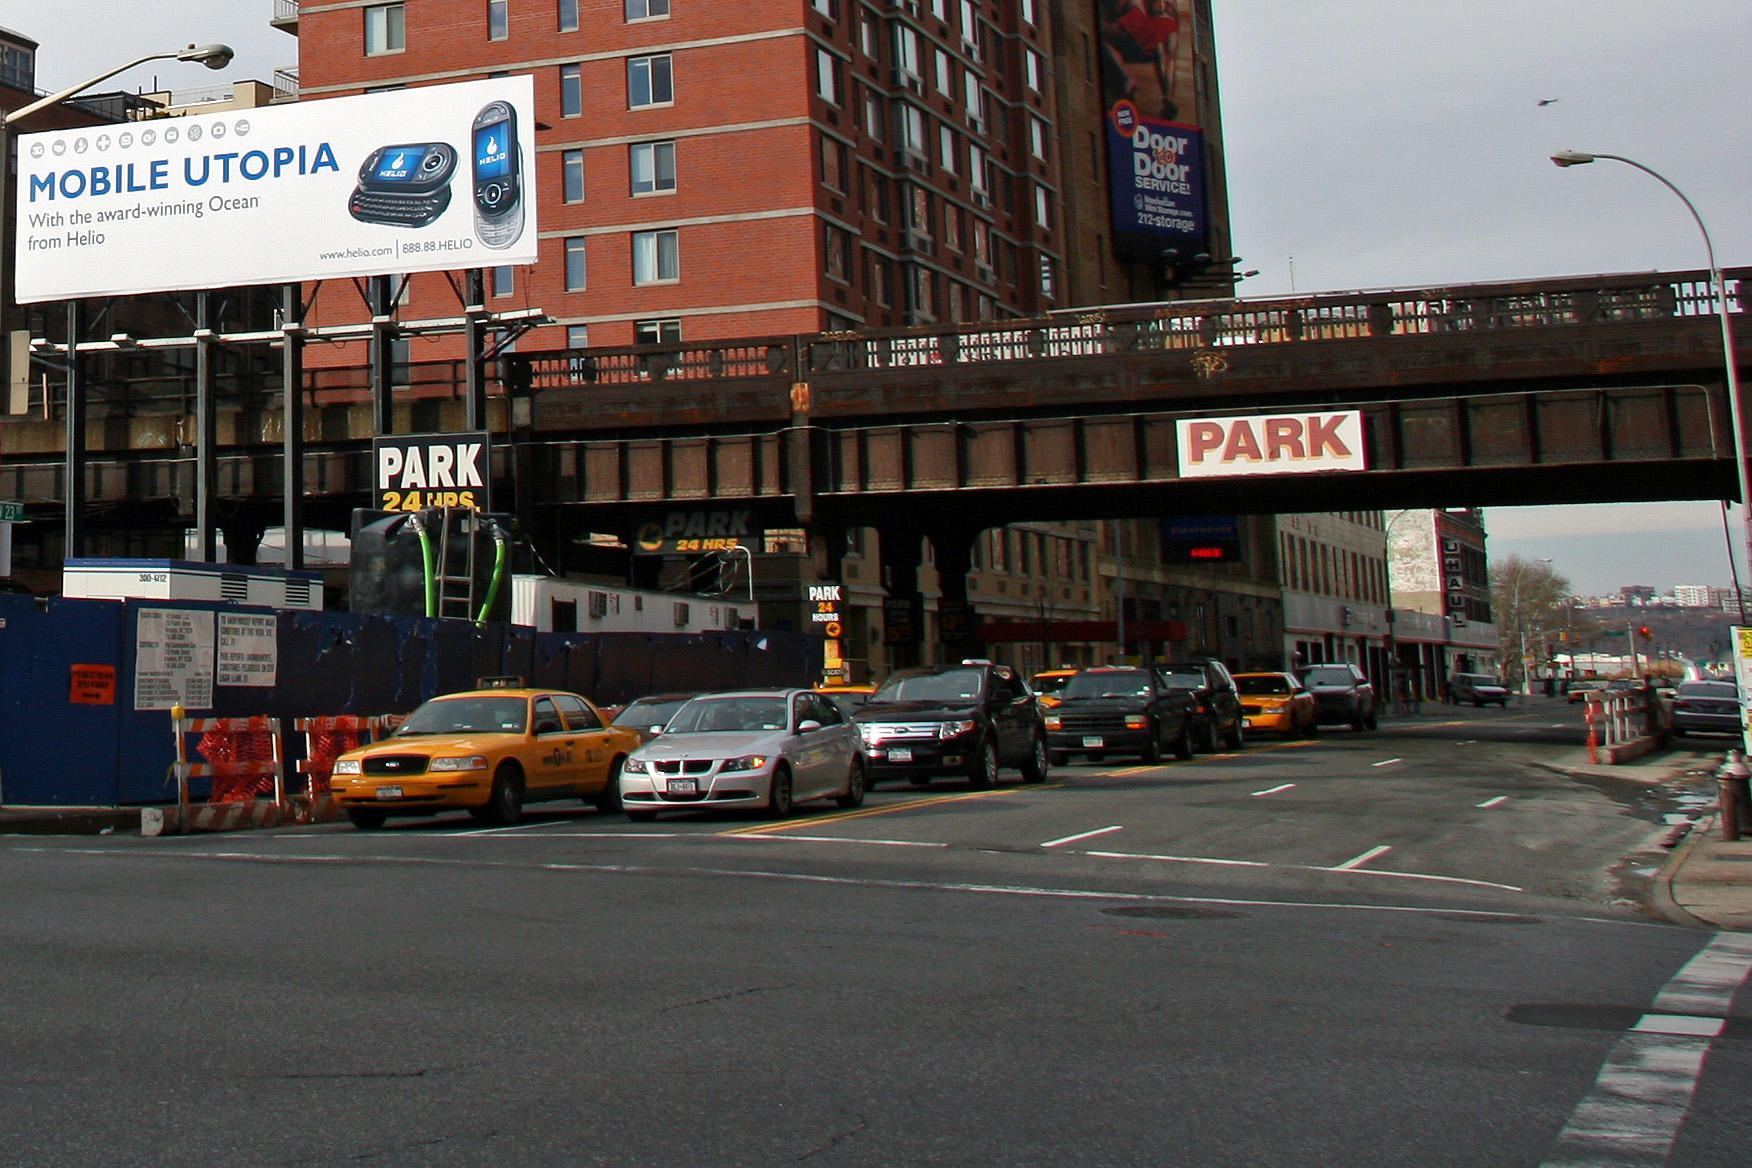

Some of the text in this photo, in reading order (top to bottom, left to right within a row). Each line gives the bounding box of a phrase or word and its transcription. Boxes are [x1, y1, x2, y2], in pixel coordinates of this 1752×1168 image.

[1133, 125, 1188, 155] Door
[29, 142, 340, 202] MOBILE UTOPIA
[1134, 152, 1190, 182] Door
[1135, 176, 1191, 195] SERVICE!
[28, 194, 259, 229] With the award-winning Ocean
[1137, 212, 1196, 233] 212-storage
[28, 230, 106, 251] from Helio
[319, 238, 473, 261] www.helio.com 888.88.HELIO
[1189, 414, 1354, 465] PARK
[379, 443, 484, 489] PARK
[4, 504, 15, 521] 23
[382, 491, 423, 513] 24
[665, 510, 751, 536] PARK
[676, 537, 738, 552] 24 HRS
[809, 585, 841, 601] PARK
[812, 612, 839, 622] HOURS
[818, 602, 834, 613] 24
